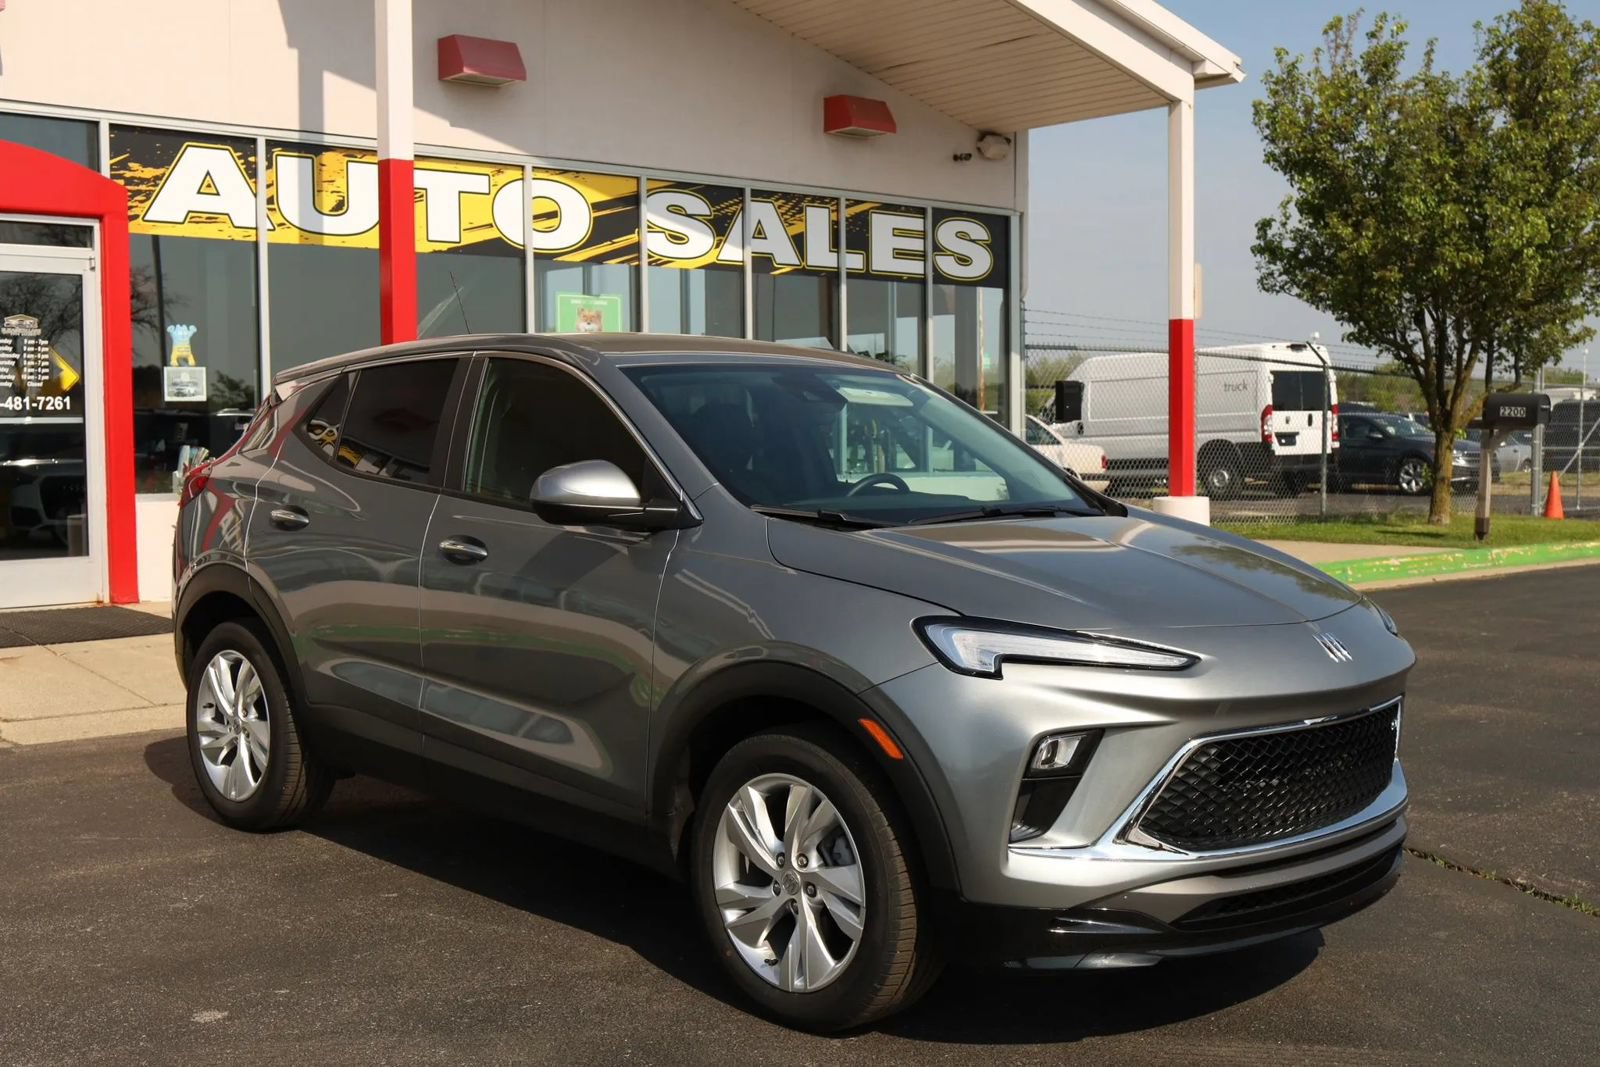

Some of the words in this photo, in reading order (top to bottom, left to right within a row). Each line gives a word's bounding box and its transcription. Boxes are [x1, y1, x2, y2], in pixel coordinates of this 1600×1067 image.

[142, 143, 592, 253] AUTO
[646, 188, 993, 281] SALES
[1224, 379, 1248, 392] truck
[1500, 406, 1526, 417] 2200
